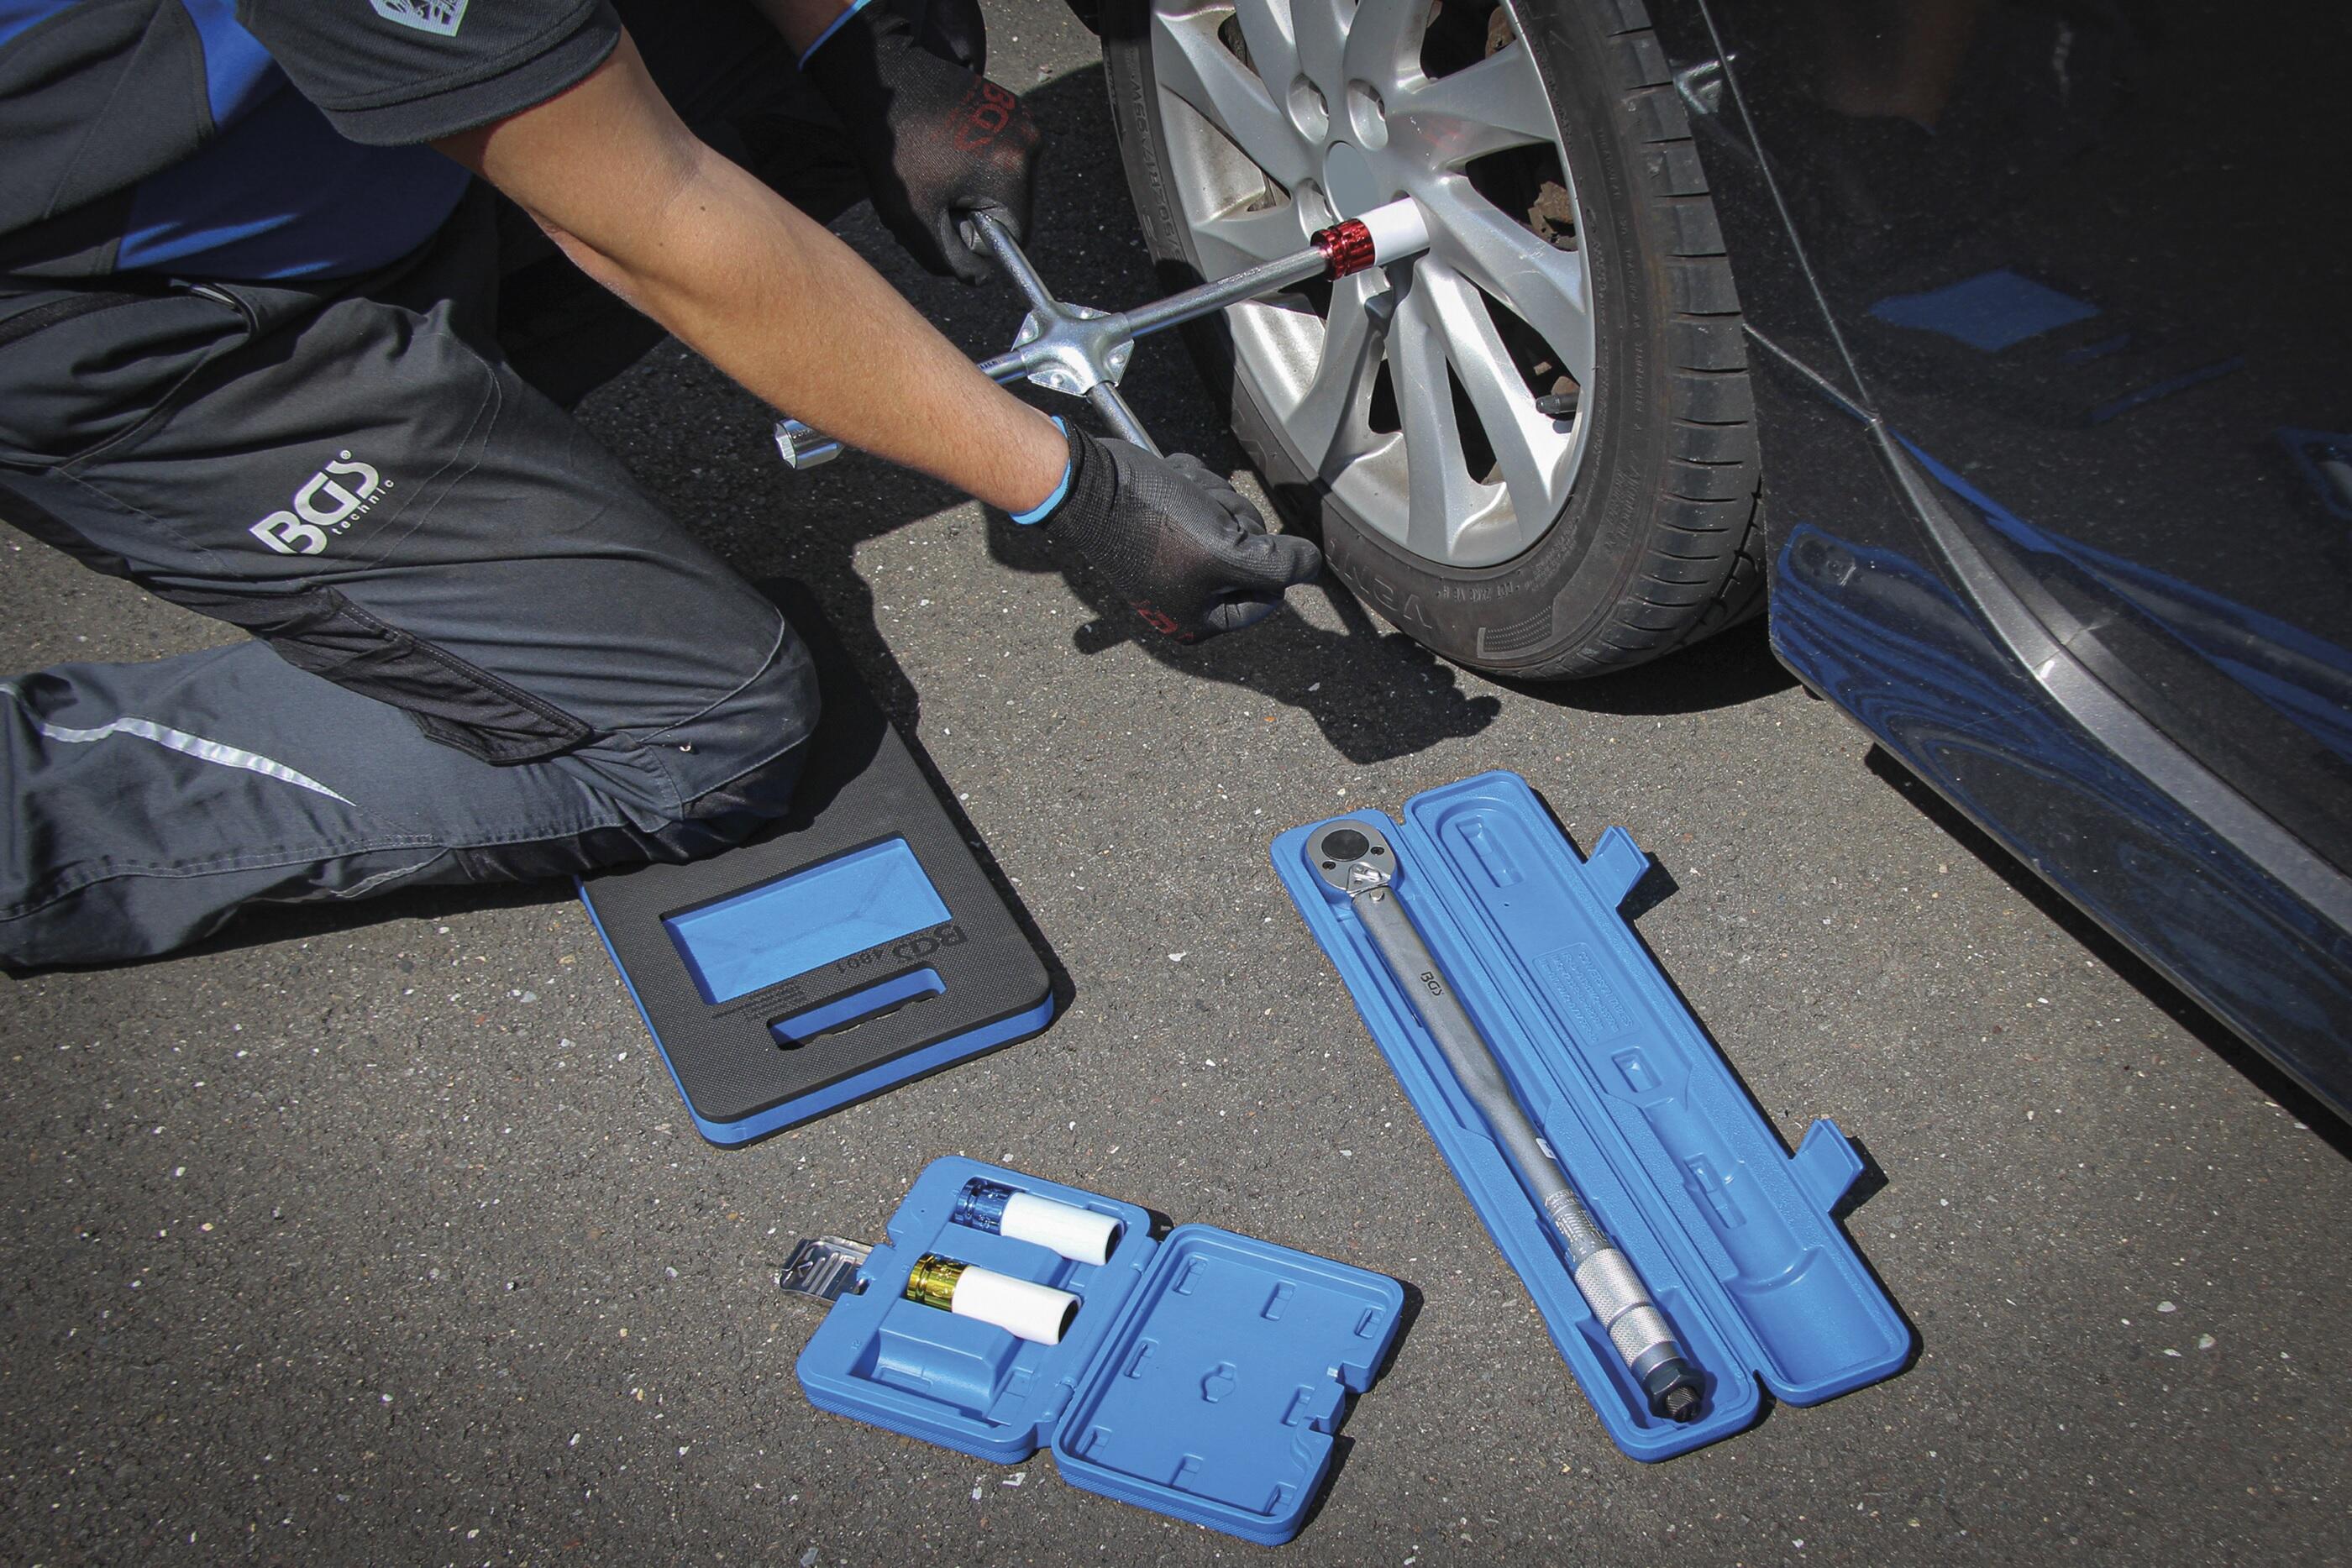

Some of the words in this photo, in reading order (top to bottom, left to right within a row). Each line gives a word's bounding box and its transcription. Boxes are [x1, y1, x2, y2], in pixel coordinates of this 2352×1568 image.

[249, 459, 379, 555] BGS
[332, 479, 395, 535] technic
[1420, 971, 1442, 997] BGS
